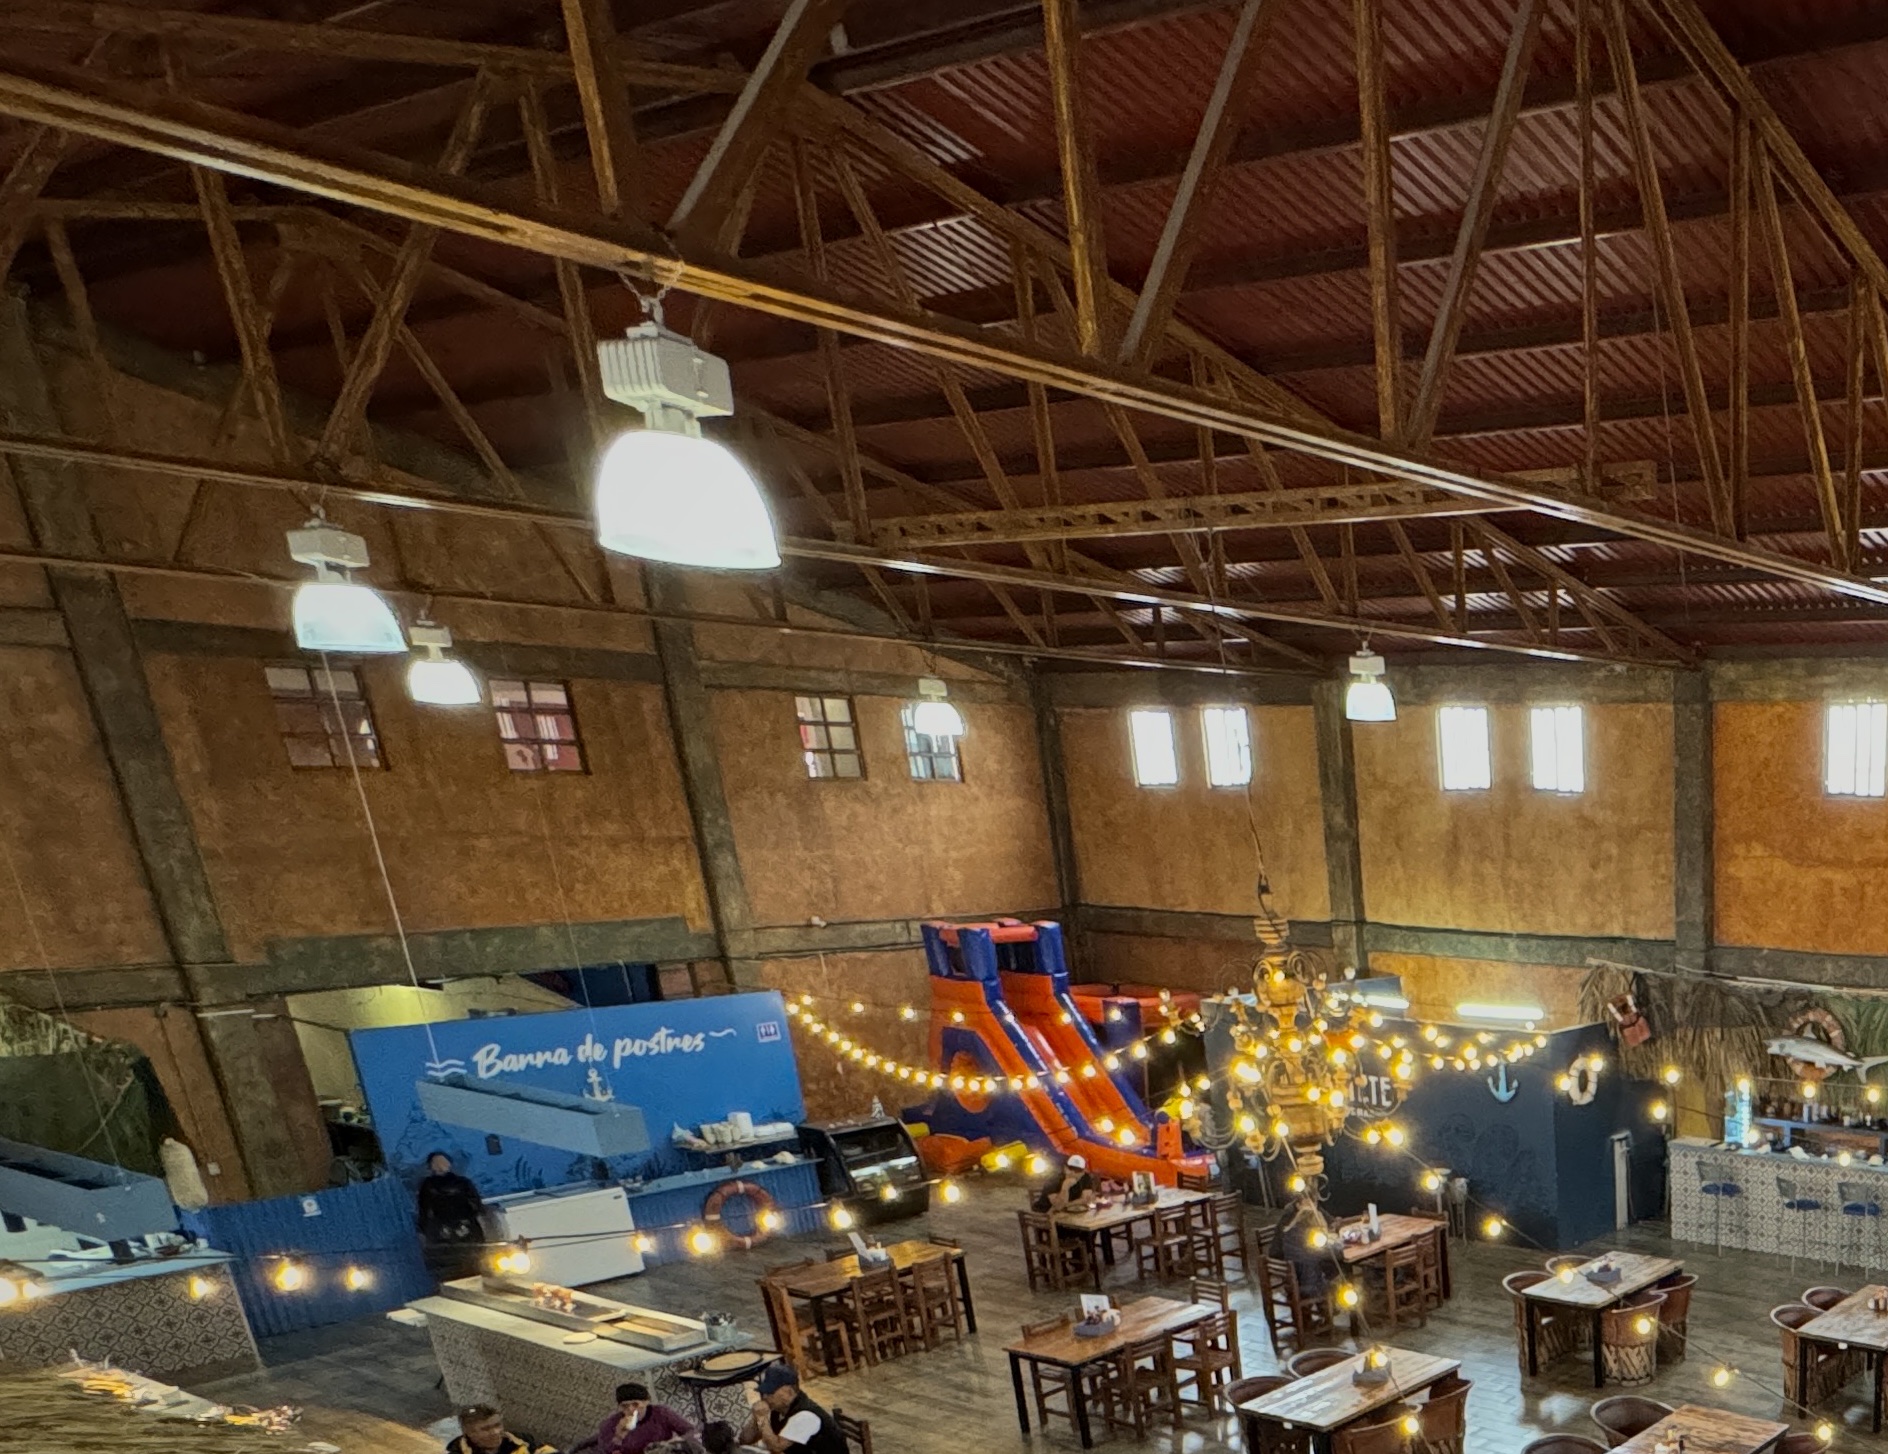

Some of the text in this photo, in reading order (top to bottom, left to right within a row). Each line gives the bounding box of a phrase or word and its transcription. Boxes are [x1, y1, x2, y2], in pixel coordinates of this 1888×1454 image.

[473, 1026, 706, 1079] Barra de postres
